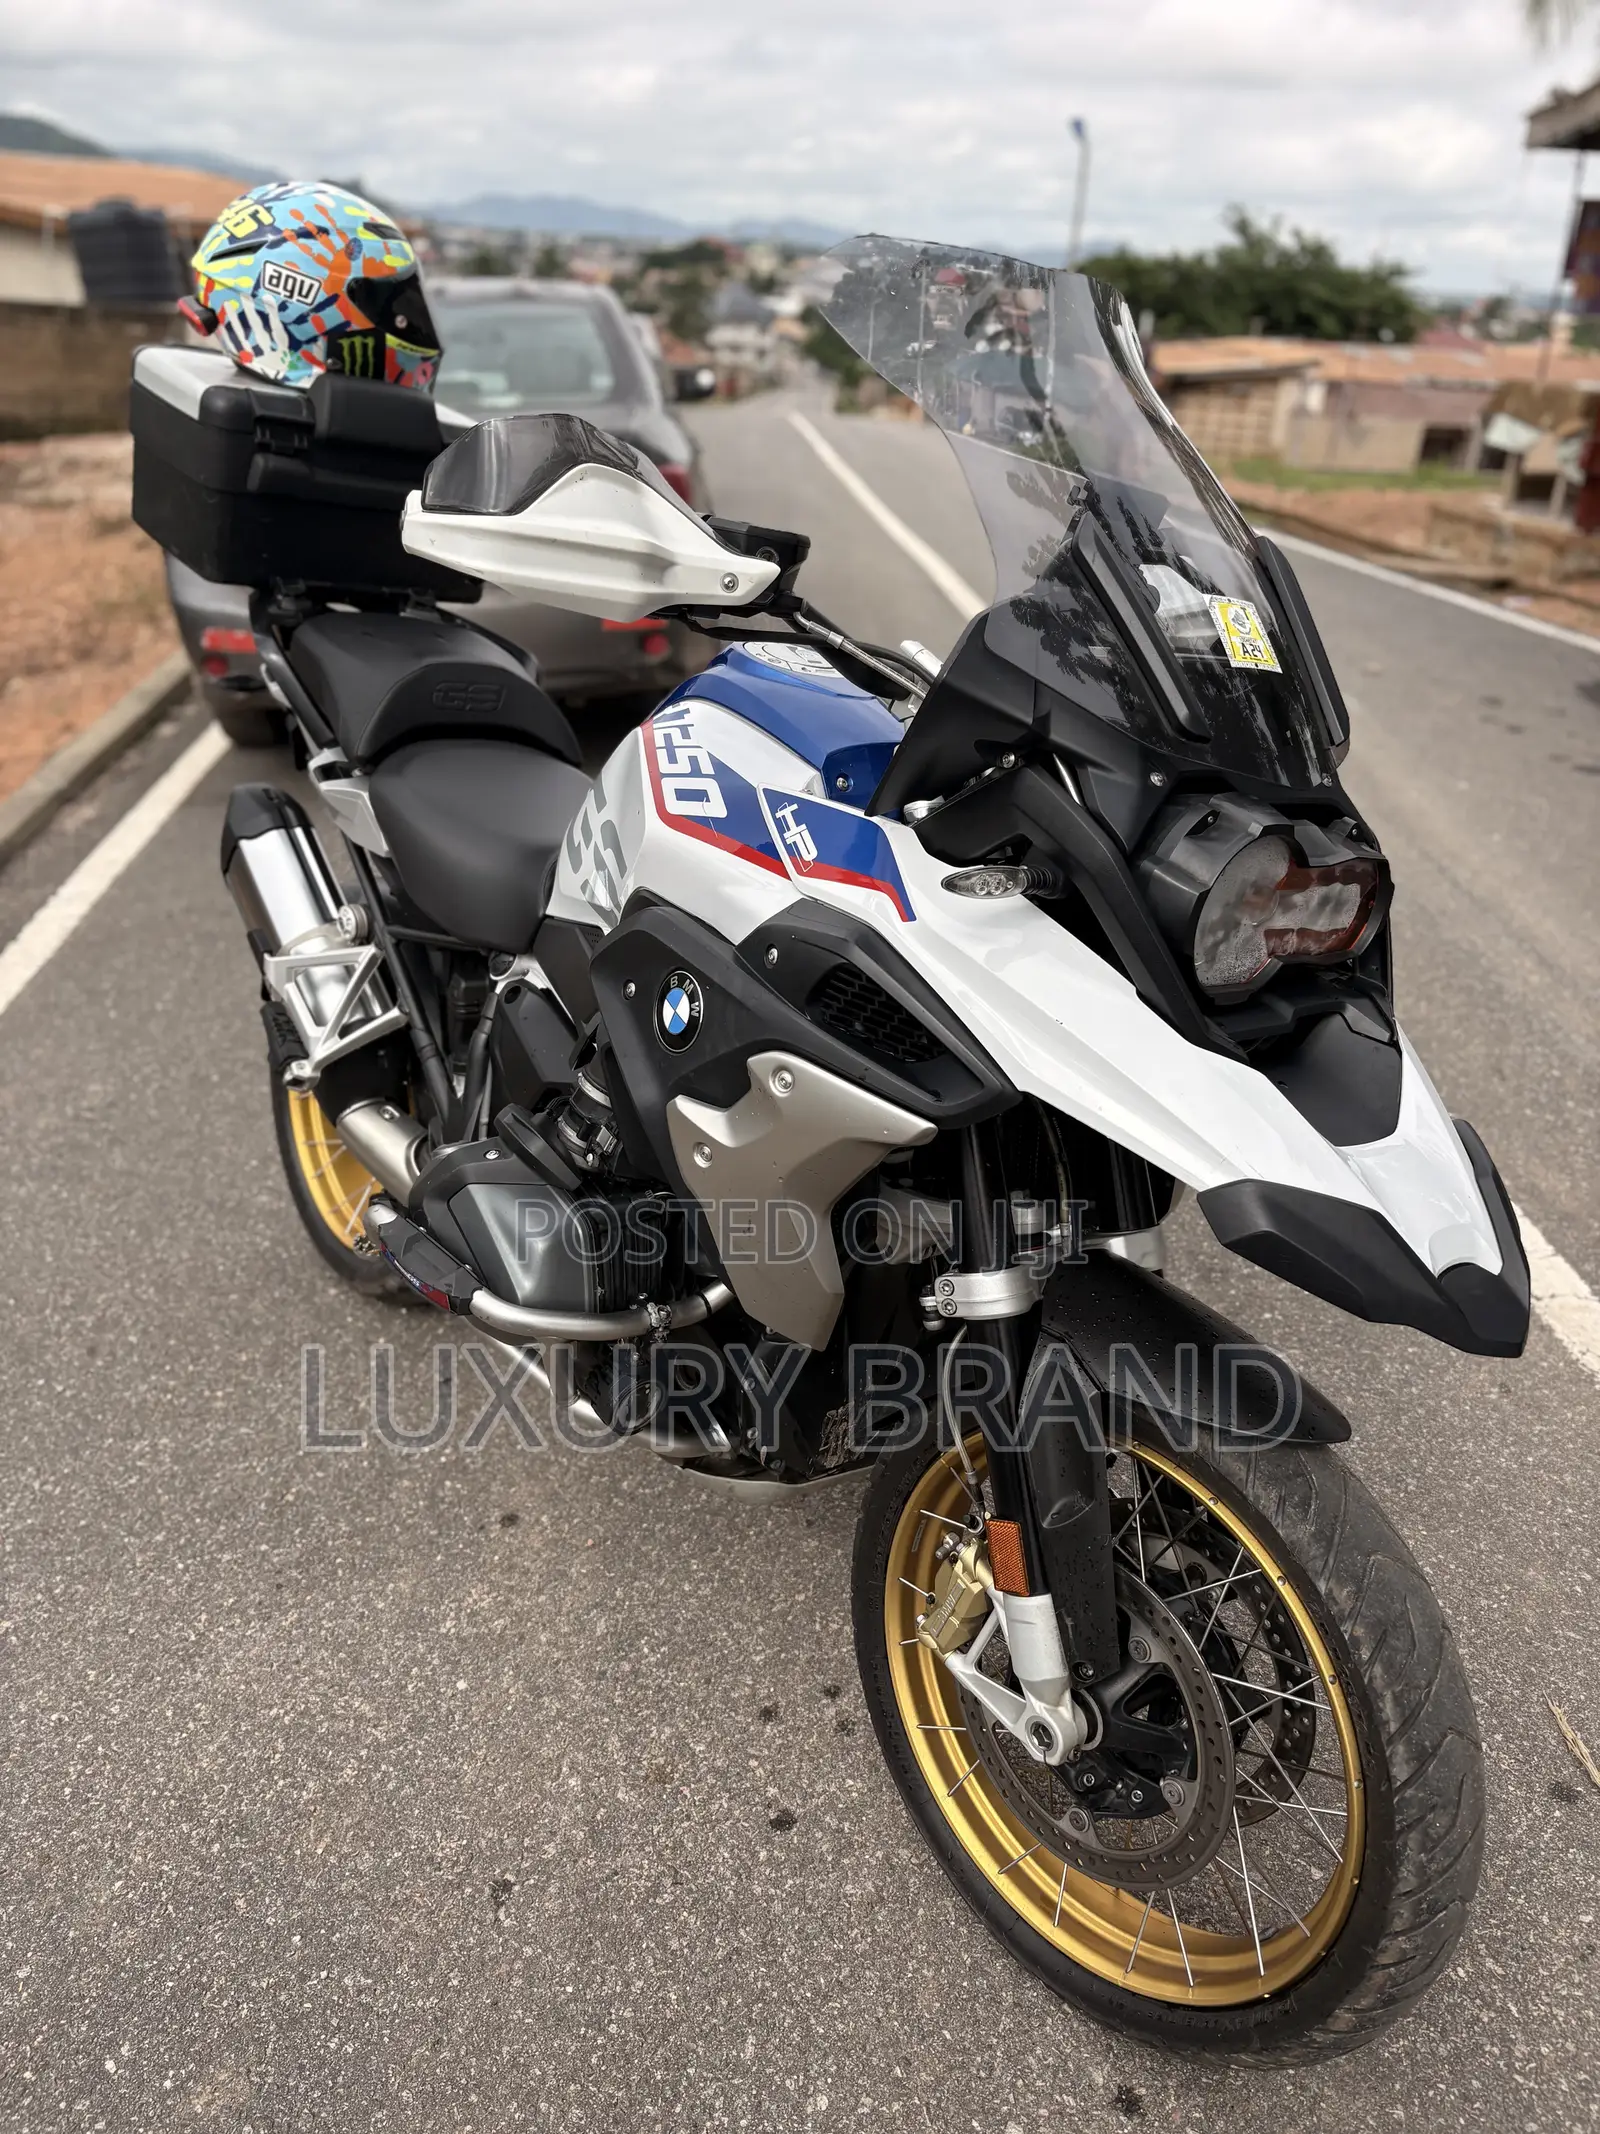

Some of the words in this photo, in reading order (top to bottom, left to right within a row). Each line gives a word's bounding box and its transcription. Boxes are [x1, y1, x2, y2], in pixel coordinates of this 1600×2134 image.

[266, 267, 316, 302] agv
[432, 682, 507, 713] GS
[775, 802, 819, 873] HP
[670, 975, 700, 1018] BMW
